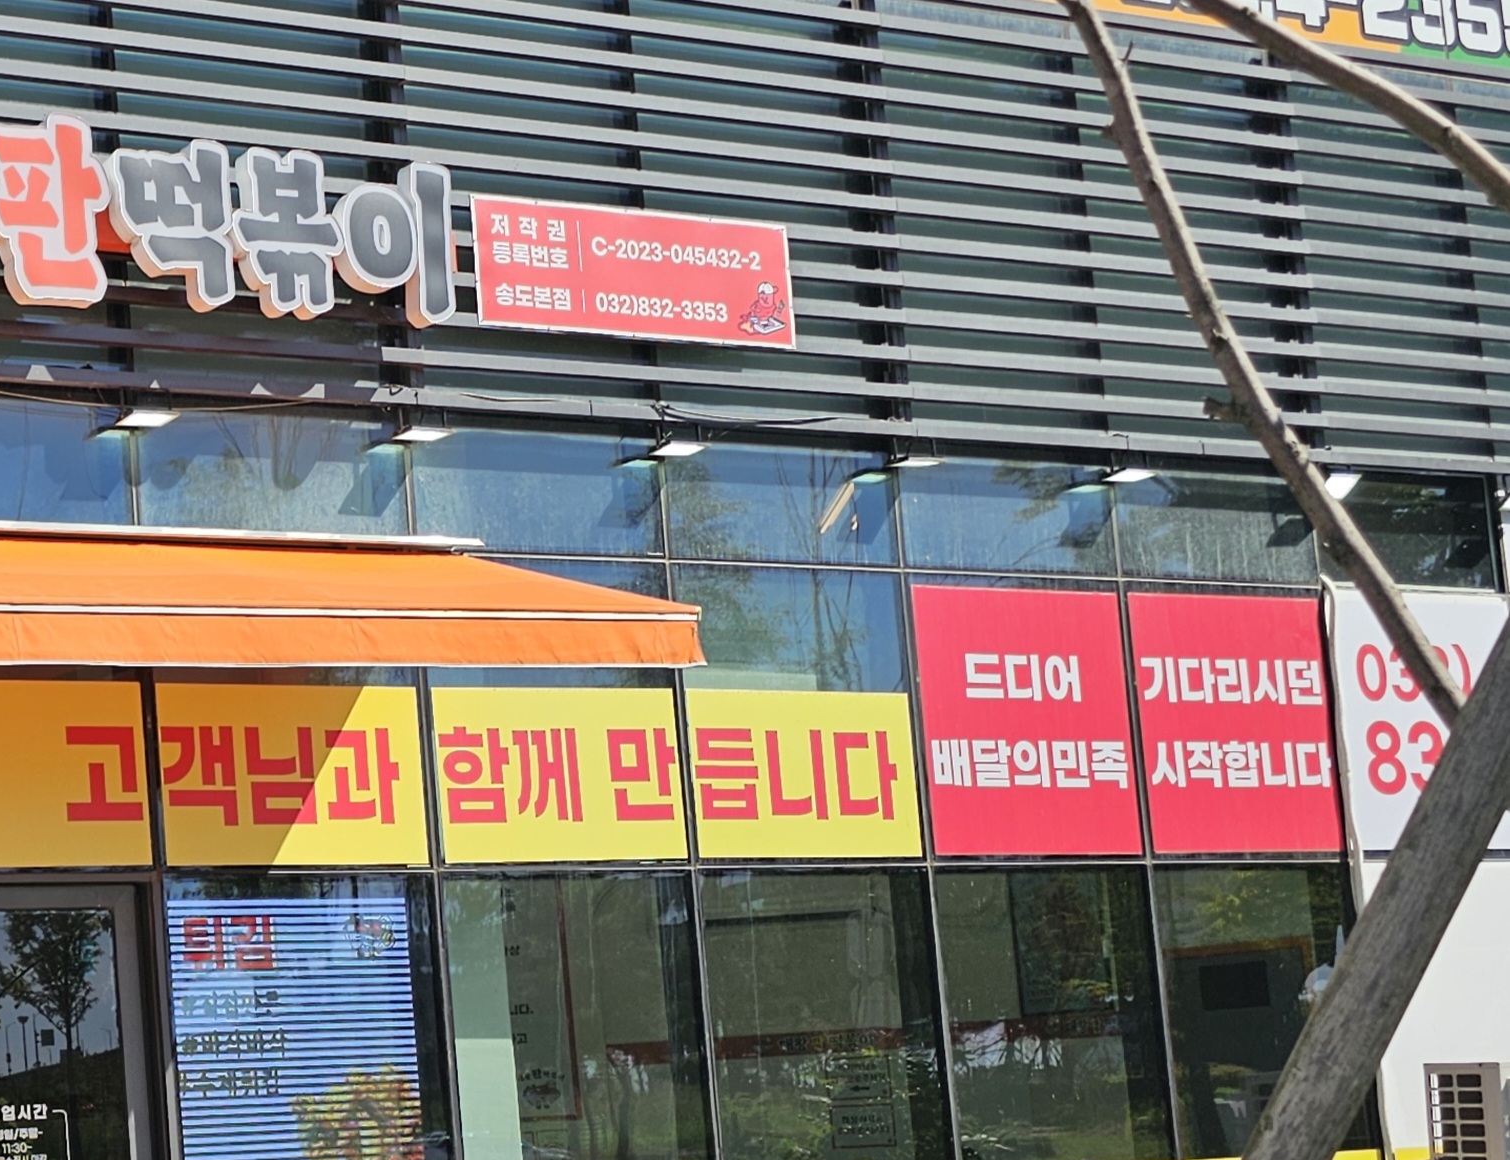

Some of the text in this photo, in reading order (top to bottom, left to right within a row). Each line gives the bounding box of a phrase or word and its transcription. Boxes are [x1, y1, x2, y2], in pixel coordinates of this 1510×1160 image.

[492, 241, 569, 269] 등록번호
[591, 237, 761, 271] C-2023-045432-2
[495, 282, 571, 311] 송도본점
[595, 293, 729, 323] 032)832-3353
[965, 653, 1082, 703] 드디어
[1141, 657, 1323, 706] 기다리시던
[65, 724, 400, 827] 고객님과
[437, 726, 584, 823] 함께
[607, 726, 898, 822] 만듭니다
[932, 739, 1129, 790] 배달의민족
[1151, 741, 1332, 789] 시작합니다
